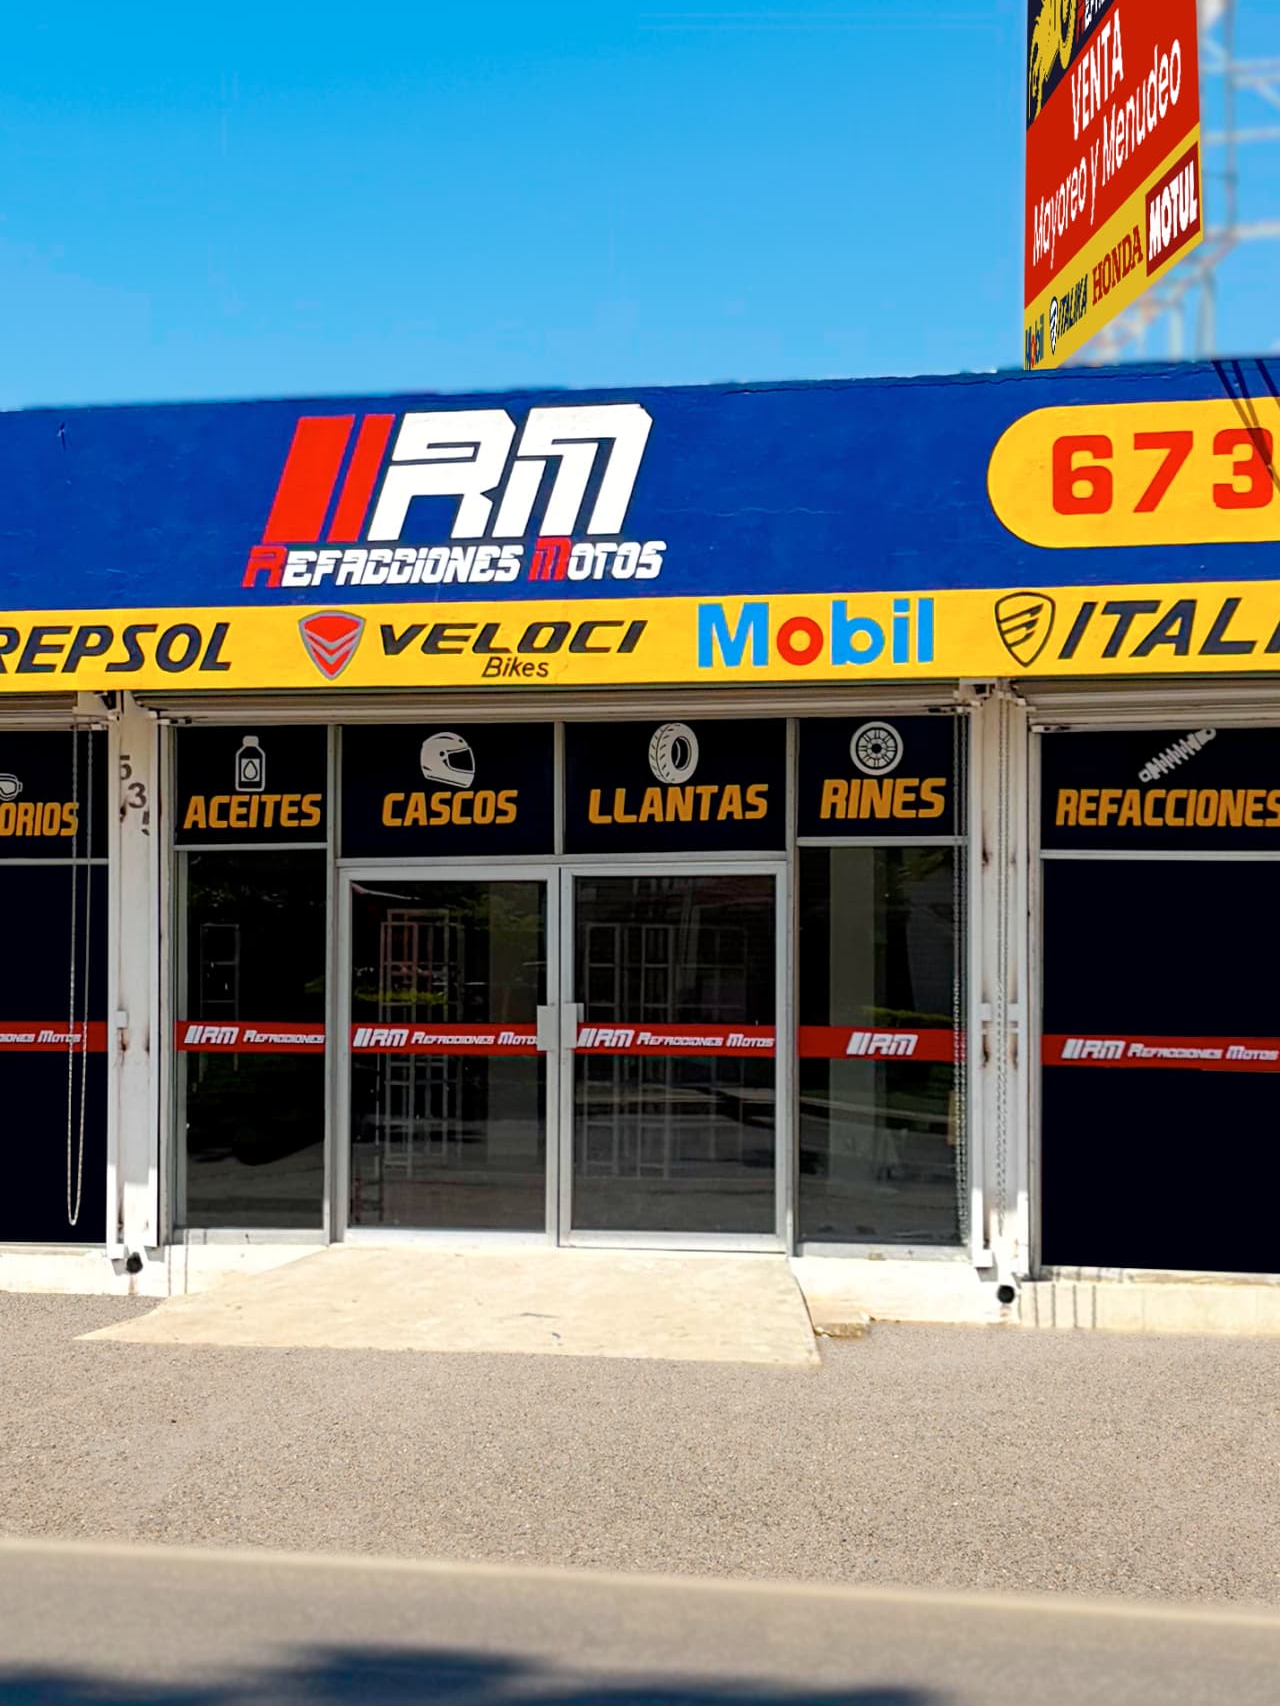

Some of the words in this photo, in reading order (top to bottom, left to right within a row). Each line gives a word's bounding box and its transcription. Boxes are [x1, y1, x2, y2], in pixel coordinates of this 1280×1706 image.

[1071, 8, 1124, 141] VENTA
[1033, 157, 1086, 269] Mayoreo
[1090, 138, 1099, 225] y
[1102, 39, 1181, 187] Menudeo
[1148, 160, 1199, 261] MOTUL
[1092, 225, 1143, 306] HONDA
[1057, 273, 1088, 339] ITALIKA
[1025, 313, 1044, 370] Mobil
[380, 620, 648, 655] VELOCI
[697, 598, 935, 668] Mobil
[482, 656, 549, 678] Bikes
[183, 794, 322, 829] ACEITES
[382, 790, 518, 827] CASCOS
[588, 783, 769, 824] LLANTAS
[820, 777, 947, 819] RINES
[498, 1032, 537, 1045] MOTO
